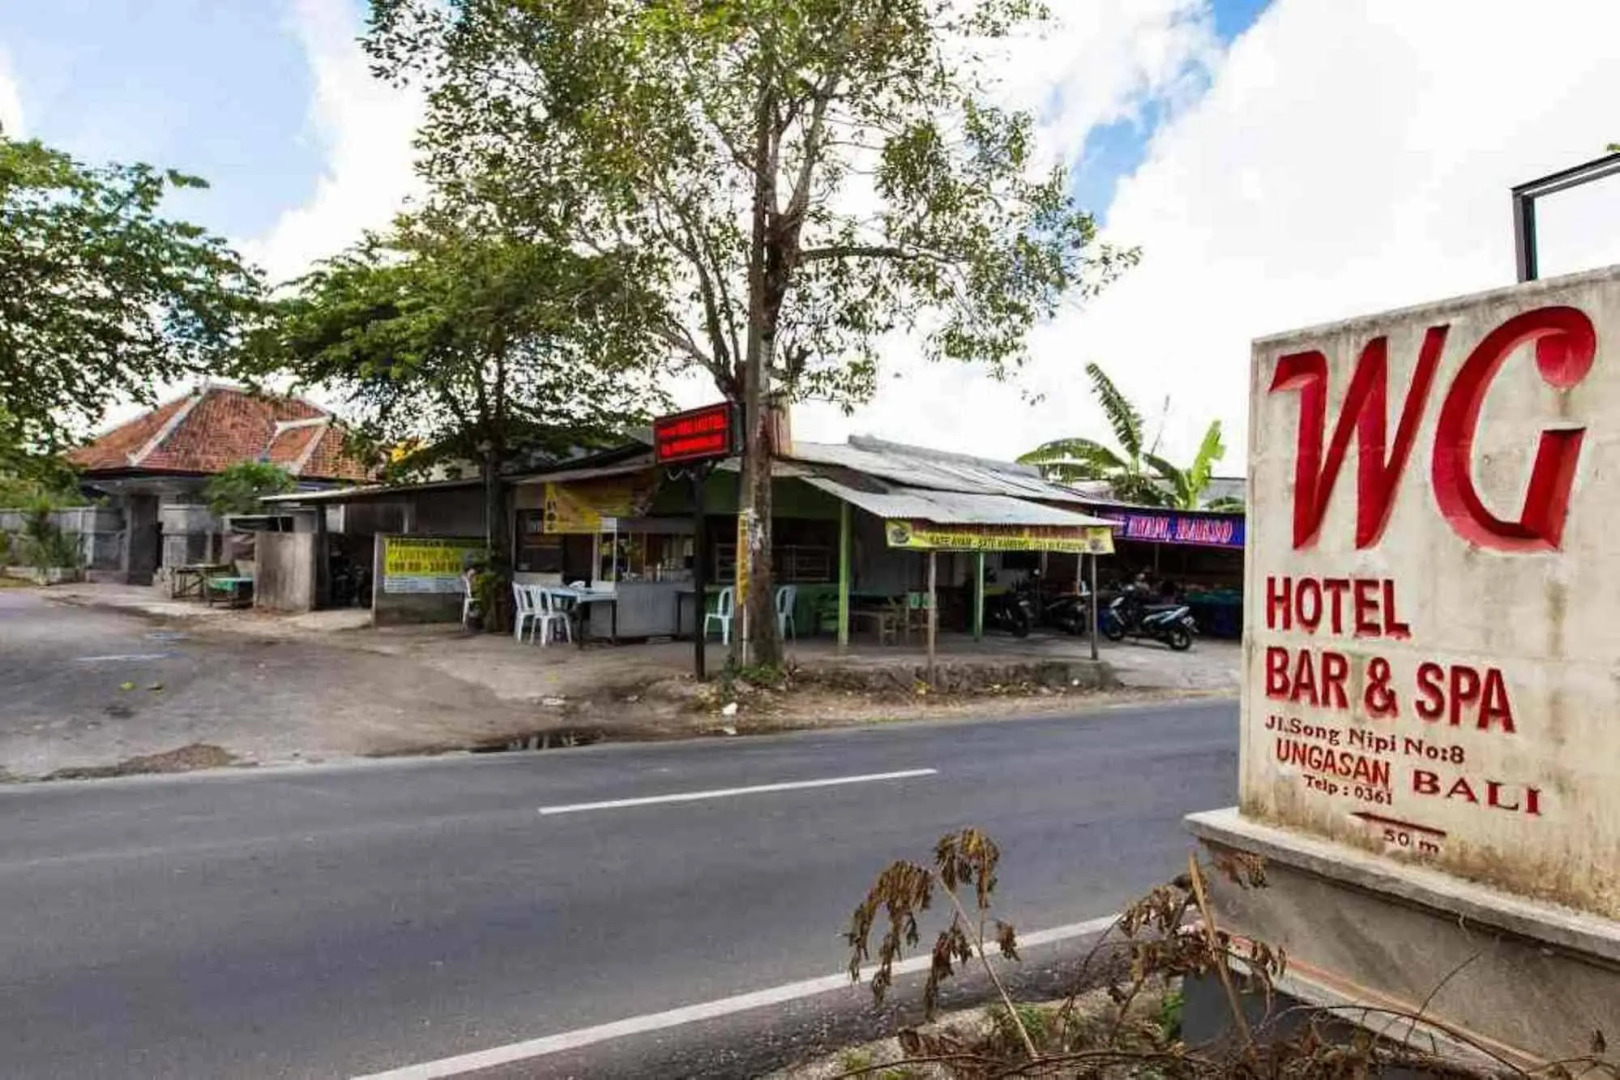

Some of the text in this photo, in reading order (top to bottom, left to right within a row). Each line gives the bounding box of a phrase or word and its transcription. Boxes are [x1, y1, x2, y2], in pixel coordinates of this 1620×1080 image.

[1268, 306, 1597, 553] WG
[1266, 576, 1411, 639] HOTEL
[1266, 646, 1516, 733] BAR & SPA
[1276, 738, 1541, 816] UNGASAN BALI
[1349, 728, 1396, 754] Nipi
[1404, 737, 1465, 764] No:8
[1354, 786, 1393, 805] 0361
[1384, 829, 1439, 853] 50 m
